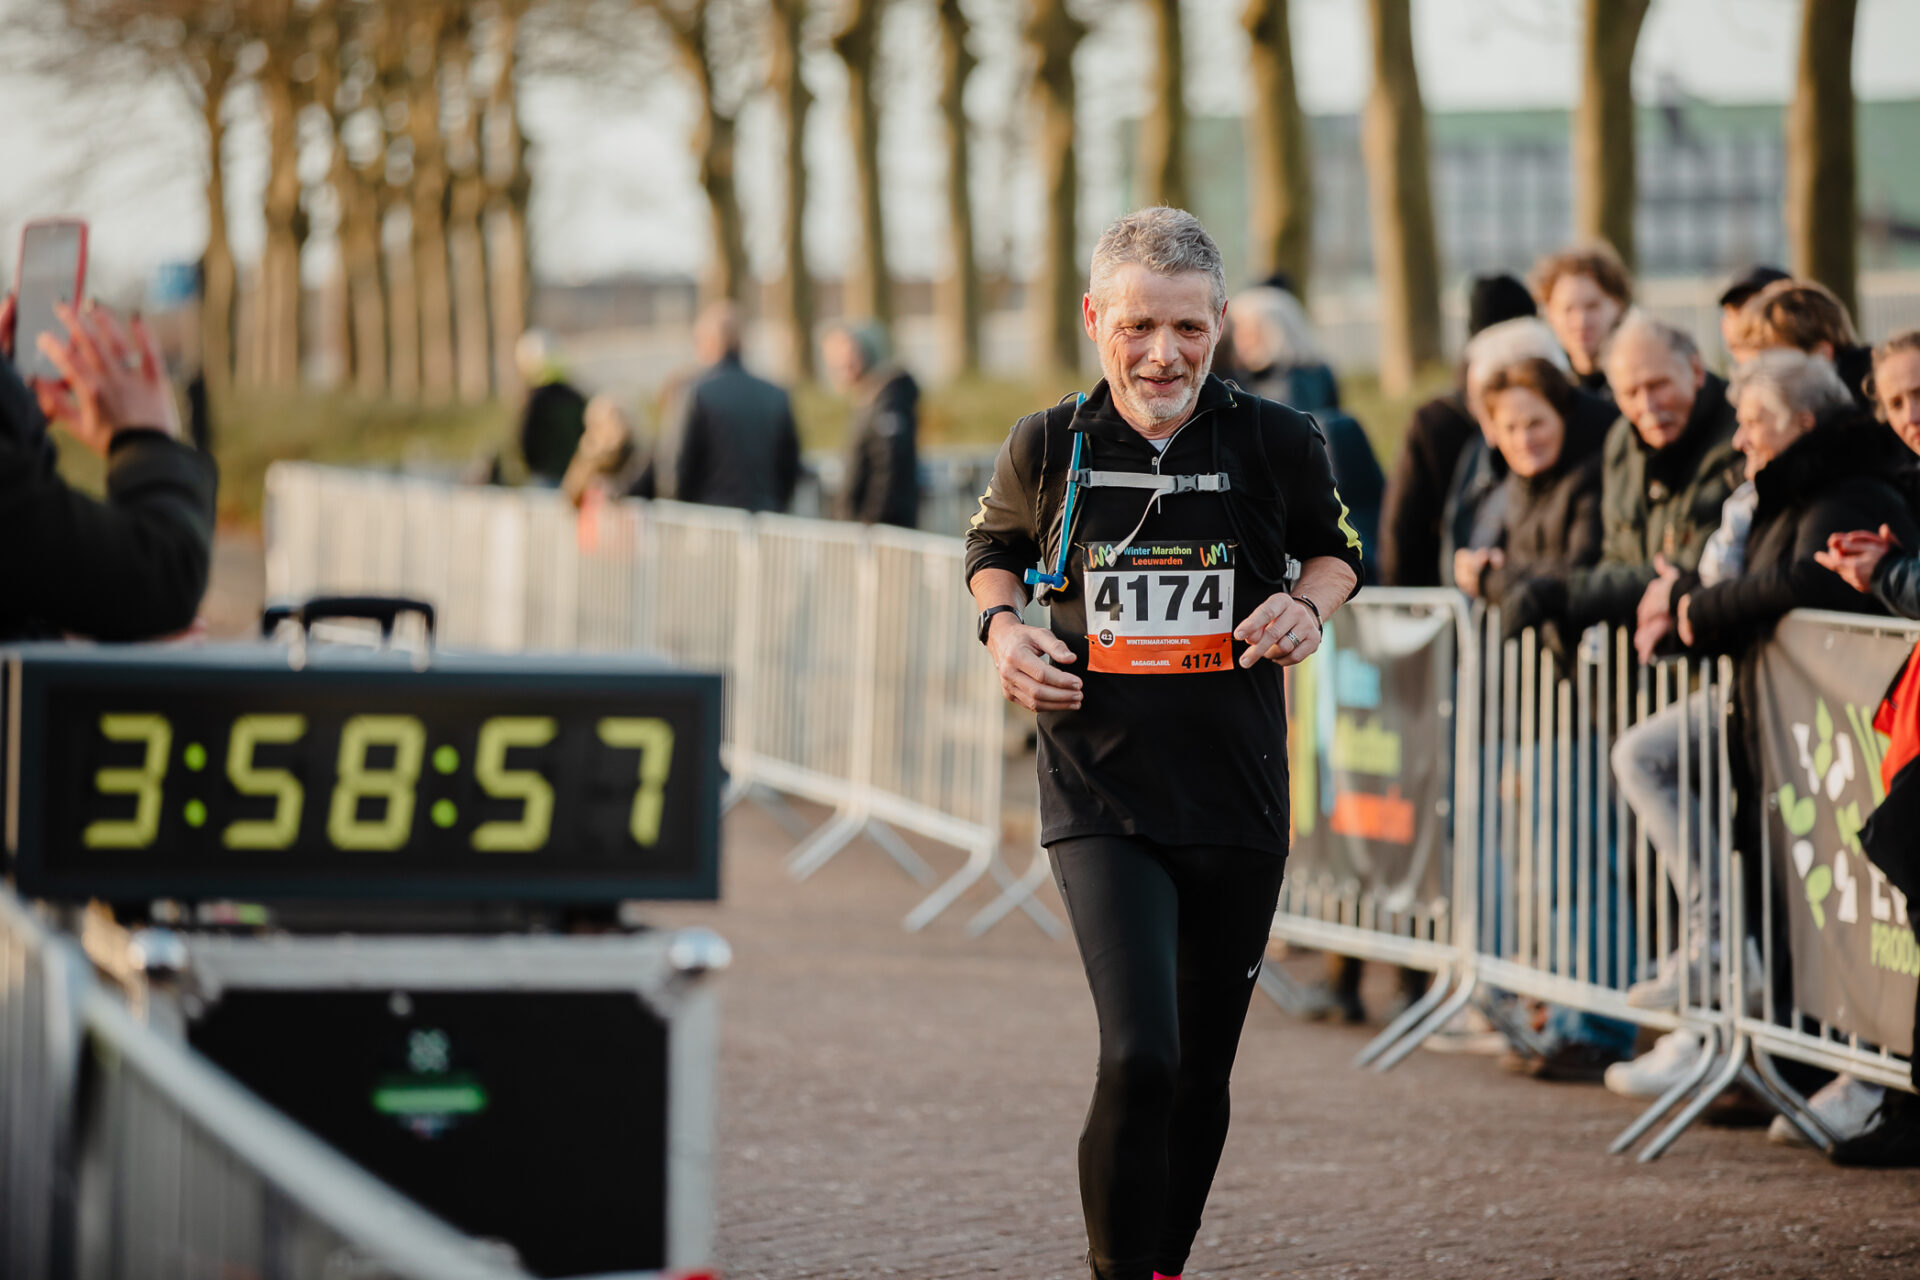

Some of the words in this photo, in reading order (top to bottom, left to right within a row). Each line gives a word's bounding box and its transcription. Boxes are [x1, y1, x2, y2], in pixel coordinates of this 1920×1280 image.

[1123, 546, 1150, 555] Winter
[1152, 546, 1192, 555] Marathon
[1132, 556, 1183, 566] Leeuwarden
[1094, 575, 1223, 622] 4174
[1181, 652, 1222, 670] 4174
[83, 713, 675, 852] 3:58:57
